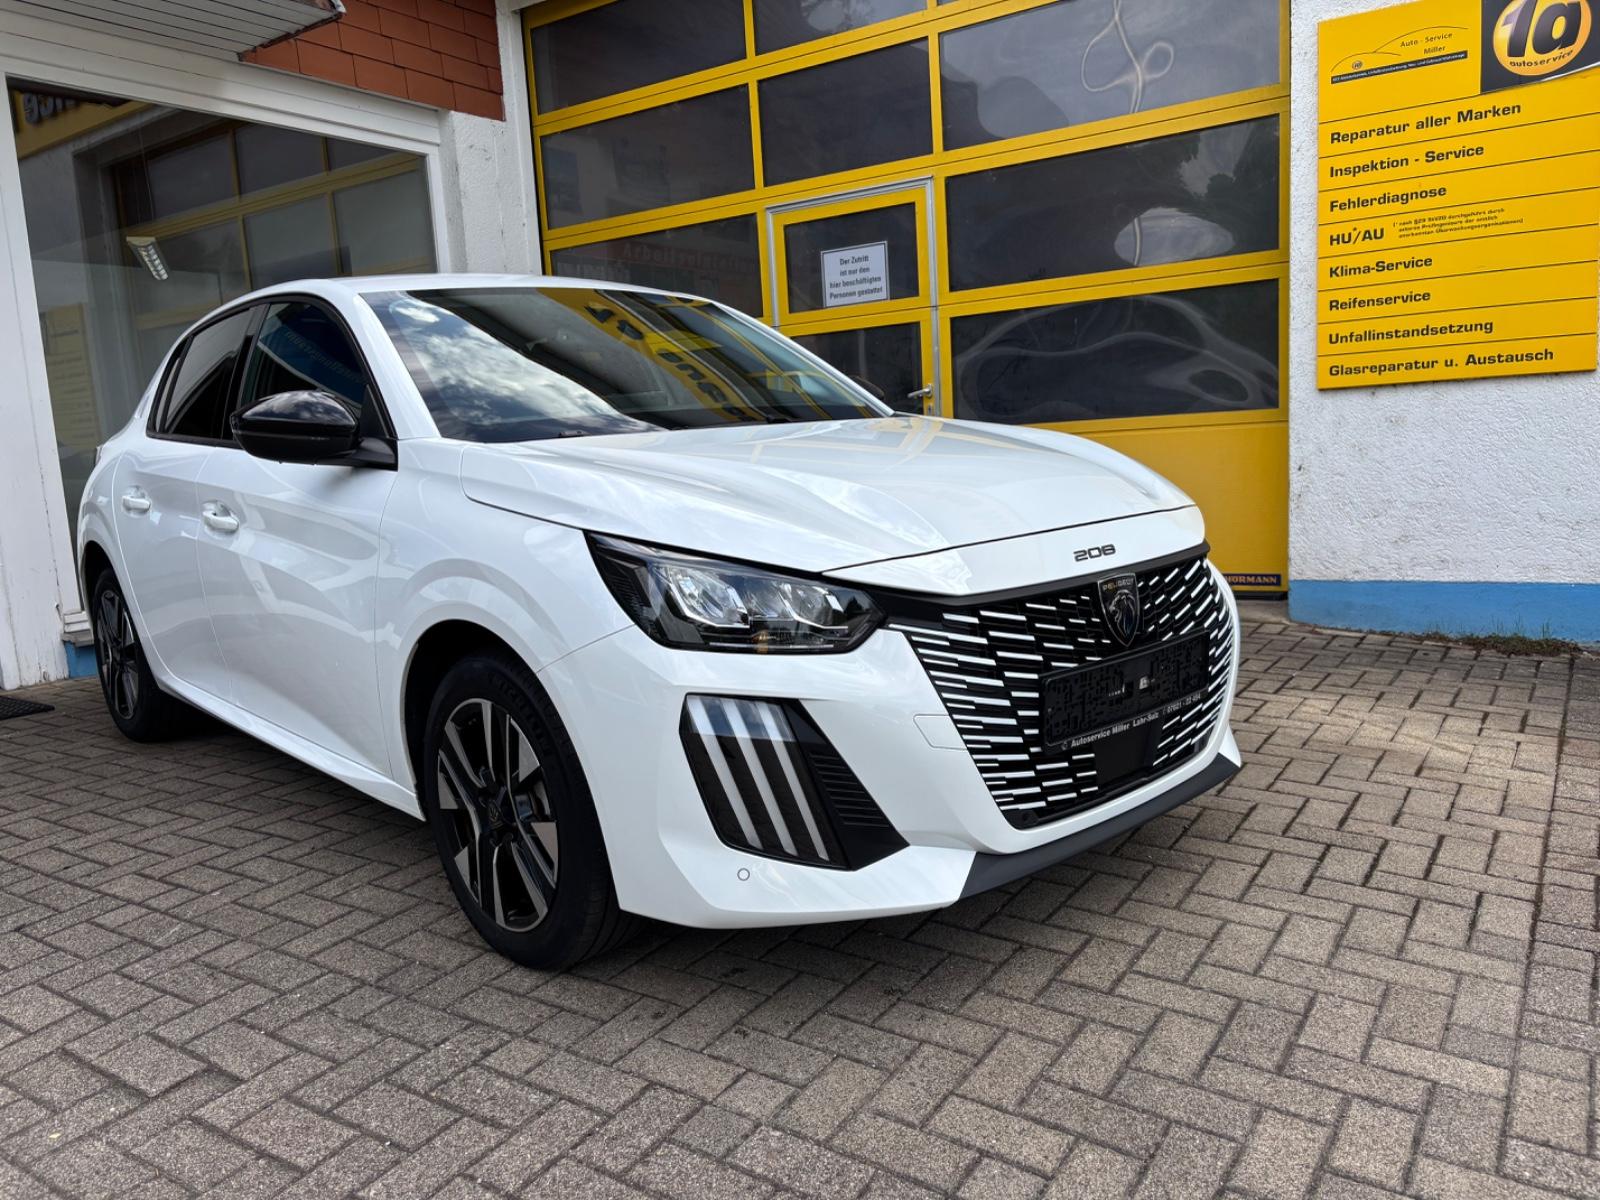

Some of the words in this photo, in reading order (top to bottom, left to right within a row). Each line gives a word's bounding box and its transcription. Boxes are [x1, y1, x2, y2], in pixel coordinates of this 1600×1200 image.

[1502, 0, 1582, 57] 1a
[1400, 39, 1419, 48] Auto
[1425, 32, 1453, 43] Service
[1423, 44, 1446, 55] Miller
[1509, 49, 1574, 68] autoservice
[1330, 122, 1410, 144] Reparatur
[1415, 111, 1451, 131] aller
[1457, 103, 1521, 123] Marken
[1329, 156, 1409, 178] Inspektion
[1424, 145, 1484, 163] Service
[1329, 186, 1447, 212] Fehlerdiagnose
[851, 255, 869, 264] Zutritt
[1329, 256, 1433, 278] Klima-Service
[829, 290, 856, 299] Personen
[1329, 291, 1431, 311] Reifenservice
[1328, 320, 1494, 345] Unfallinstandsetzung
[1329, 358, 1439, 376] Glasreparatur
[1444, 357, 1459, 368] u.
[1465, 348, 1554, 367] Austausch
[1073, 544, 1116, 562] 208
[1102, 577, 1135, 592] PEUGEOT
[1071, 728, 1111, 748] Autoservice
[1112, 722, 1130, 735] Miller
